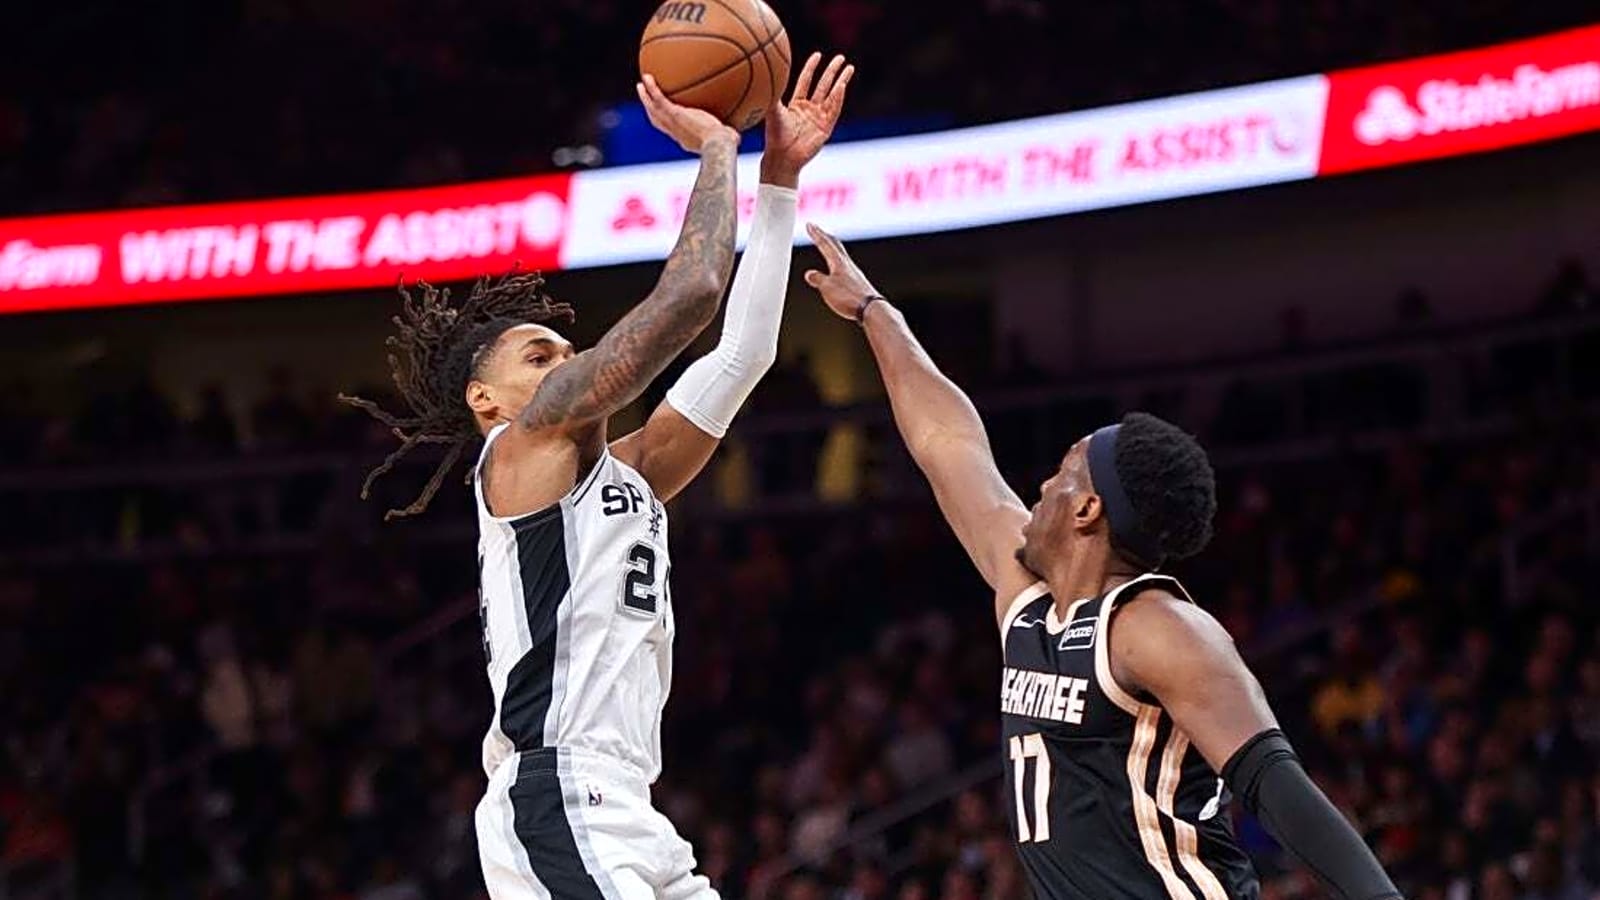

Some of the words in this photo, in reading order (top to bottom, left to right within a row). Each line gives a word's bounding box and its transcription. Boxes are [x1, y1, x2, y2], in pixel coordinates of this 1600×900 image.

[887, 158, 1008, 206] WITH
[1021, 138, 1099, 187] THE
[1118, 115, 1273, 173] ASSIST
[119, 224, 259, 285] WITH
[264, 216, 366, 274] THE
[364, 202, 521, 266] ASSIST
[1009, 732, 1051, 843] 17
